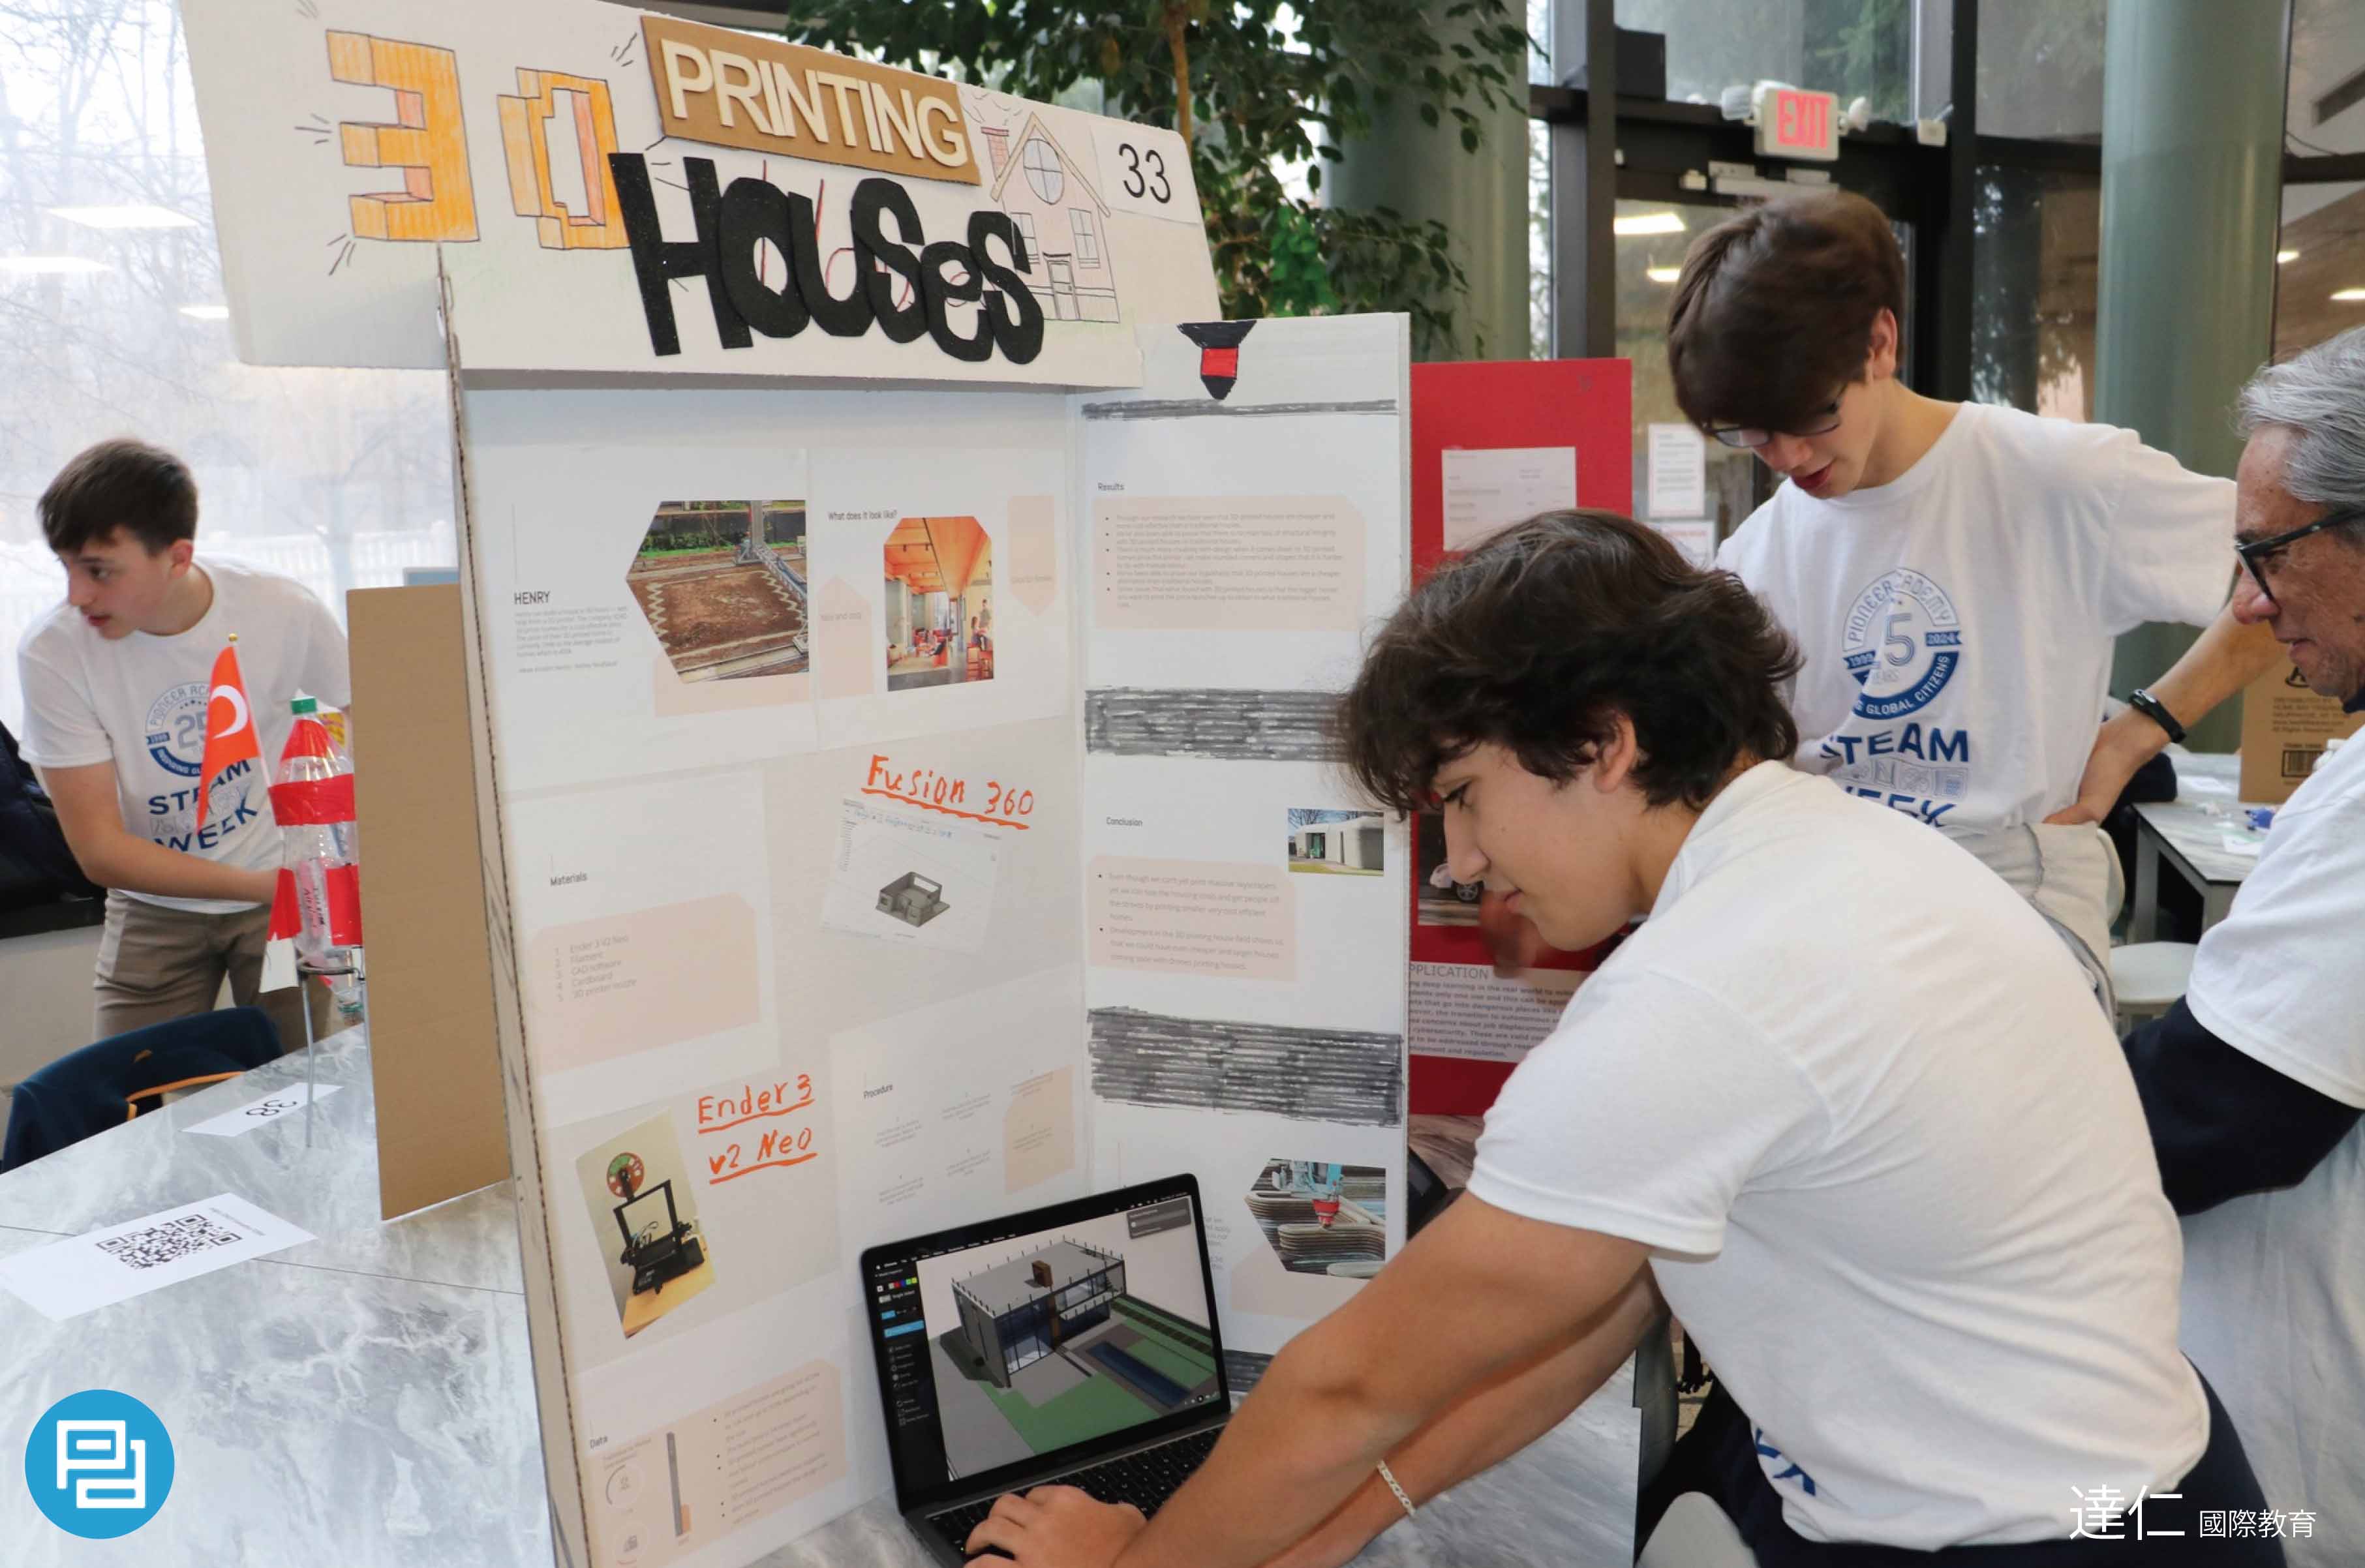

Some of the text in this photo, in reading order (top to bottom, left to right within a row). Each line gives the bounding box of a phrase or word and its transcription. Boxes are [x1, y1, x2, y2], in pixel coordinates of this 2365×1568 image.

[660, 38, 968, 167] PRINTING
[1778, 90, 1831, 148] EXIT
[1119, 143, 1171, 204] 33
[1097, 483, 1125, 491] Results
[829, 512, 844, 520] What
[847, 511, 861, 520] does
[863, 511, 868, 520] it
[869, 510, 881, 519] look
[514, 591, 551, 605] HENRY
[1848, 575, 1951, 642] PIONEER ADEMY
[1866, 655, 1950, 715] GLOBAL CITIZENS
[867, 754, 1034, 816] Fusion 360
[1106, 817, 1143, 827] Conclusion
[550, 871, 588, 887] Materials
[697, 1074, 812, 1124] Ender 3
[863, 1083, 893, 1100] Procedure
[589, 1436, 608, 1449] Data
